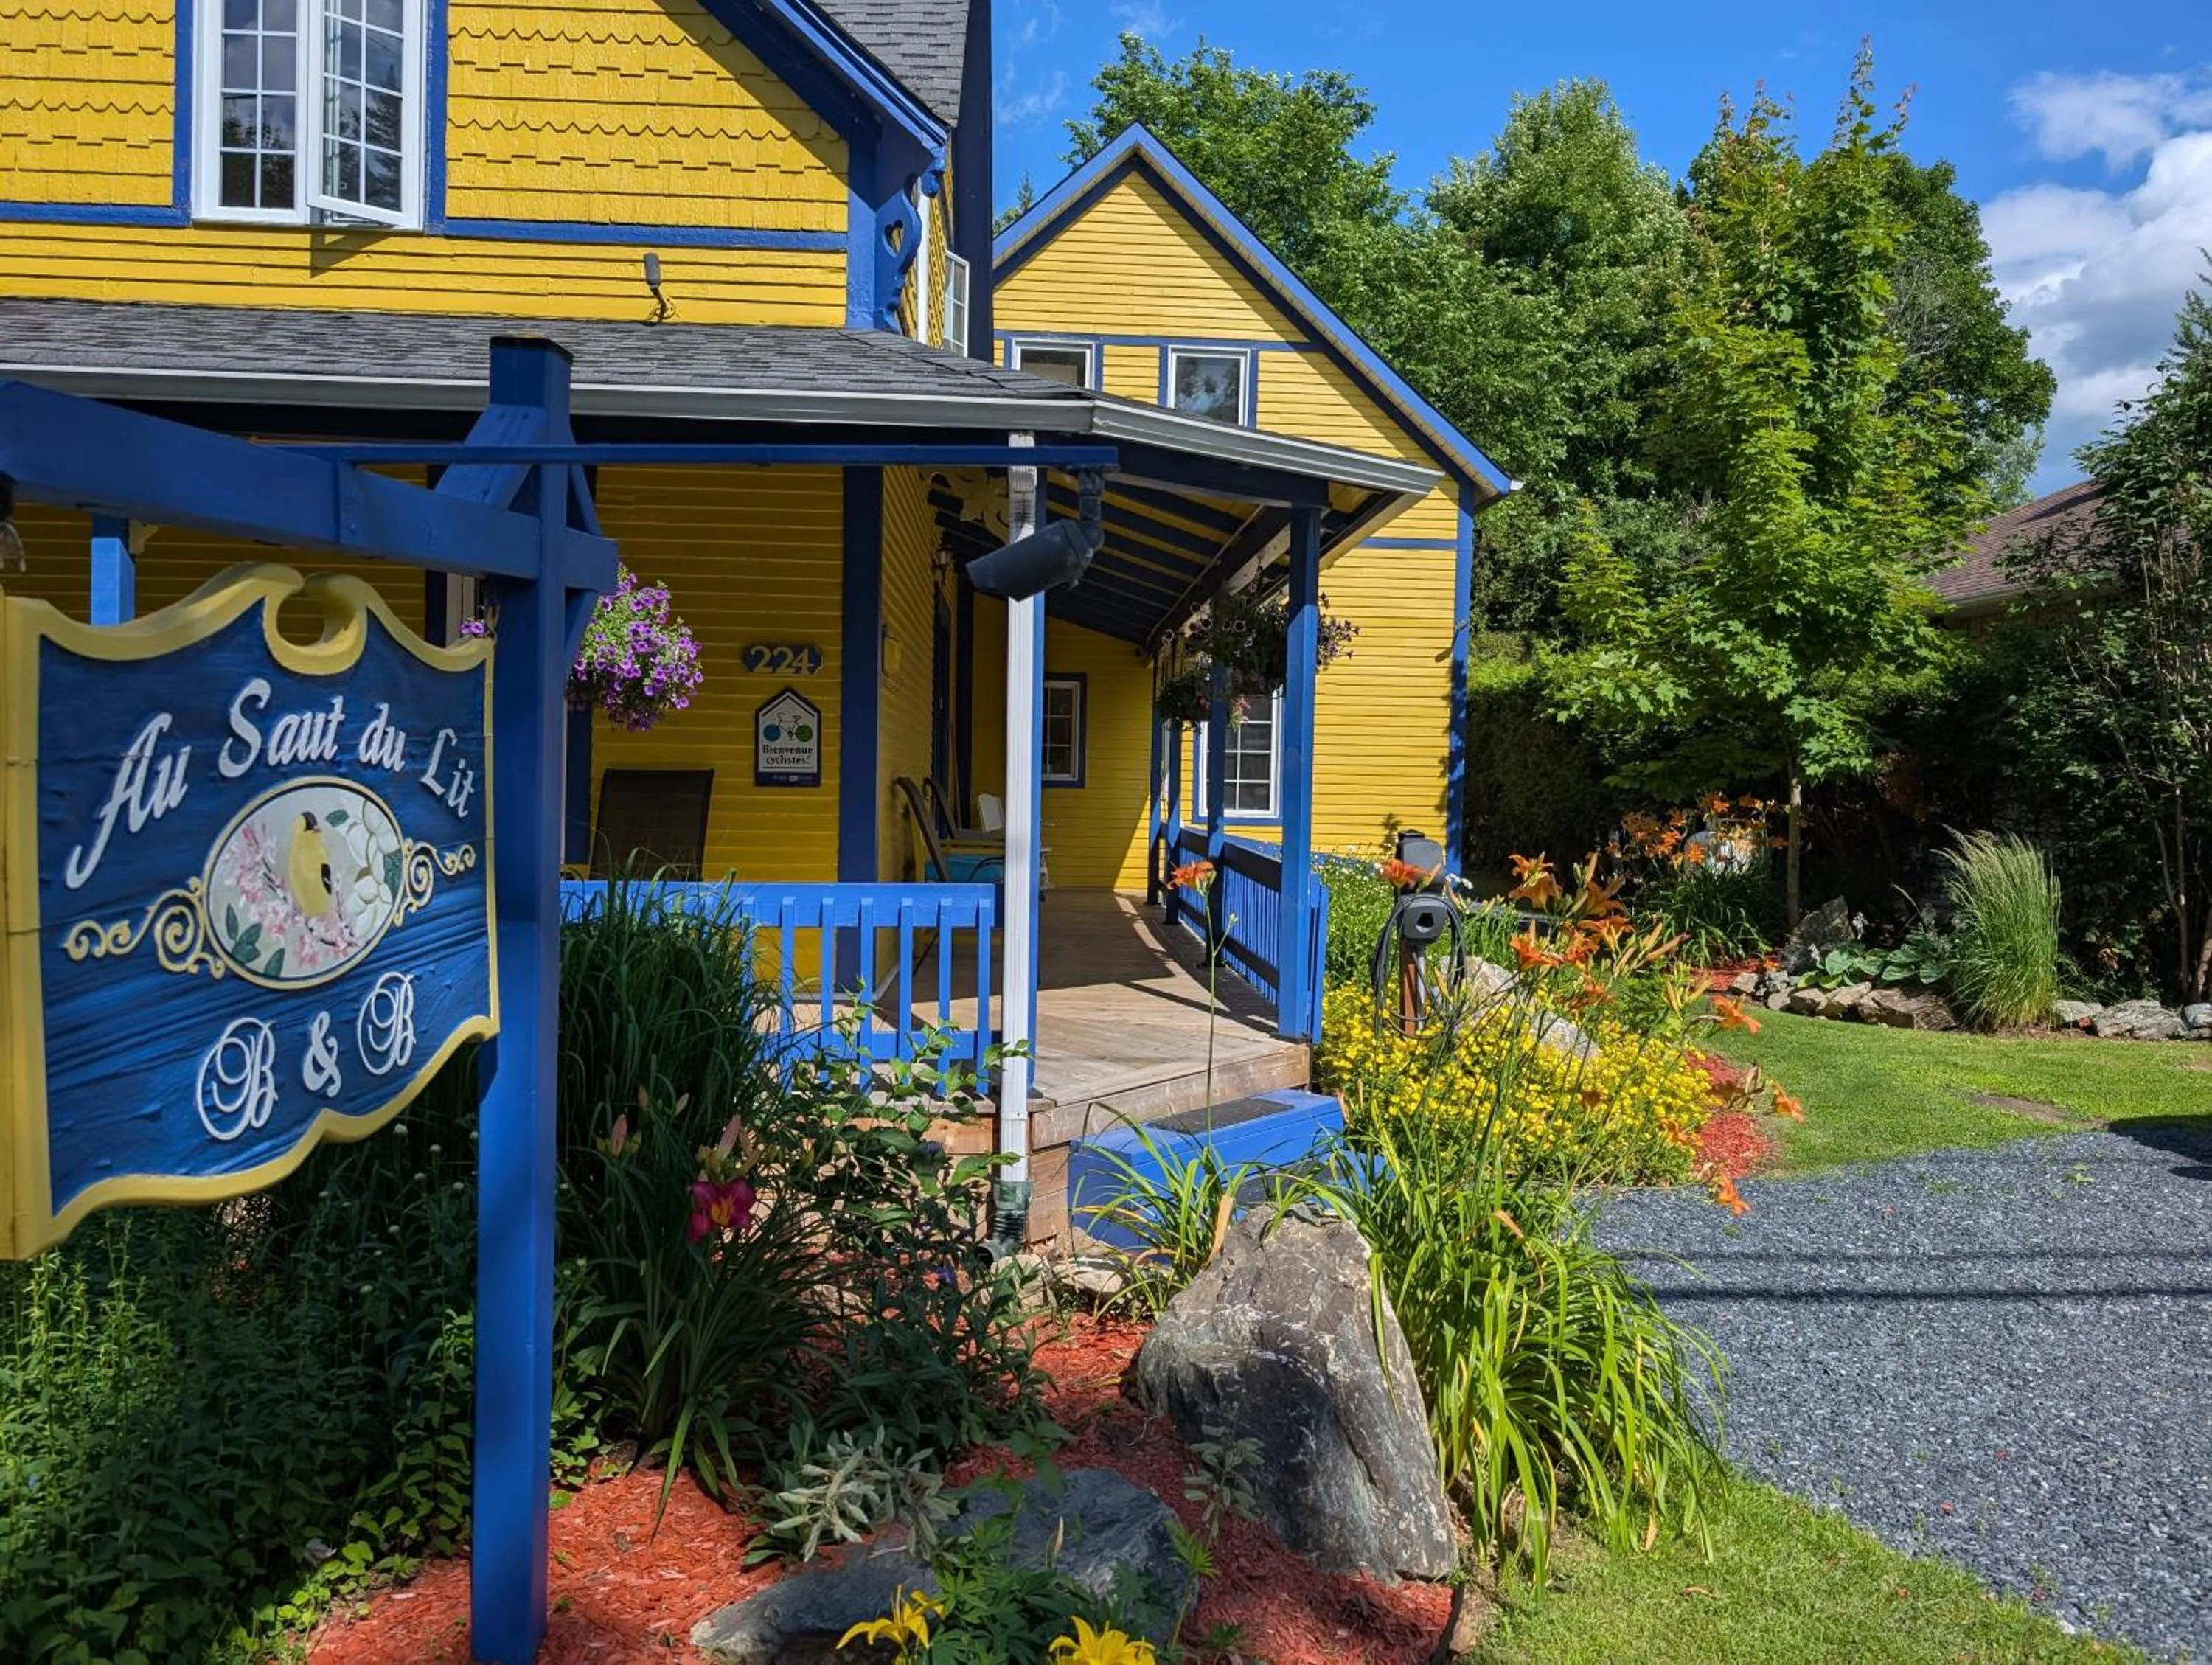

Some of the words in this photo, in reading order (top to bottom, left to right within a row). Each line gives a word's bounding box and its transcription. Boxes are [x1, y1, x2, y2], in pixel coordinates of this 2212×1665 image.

[749, 645, 815, 675] 224
[66, 712, 192, 889] Au
[218, 678, 346, 778] Saut
[358, 703, 406, 772] du
[420, 728, 475, 818] Lit
[762, 744, 813, 754] Bienvenue
[196, 1017, 279, 1141] B
[303, 1011, 341, 1097] &
[357, 971, 417, 1075] B
